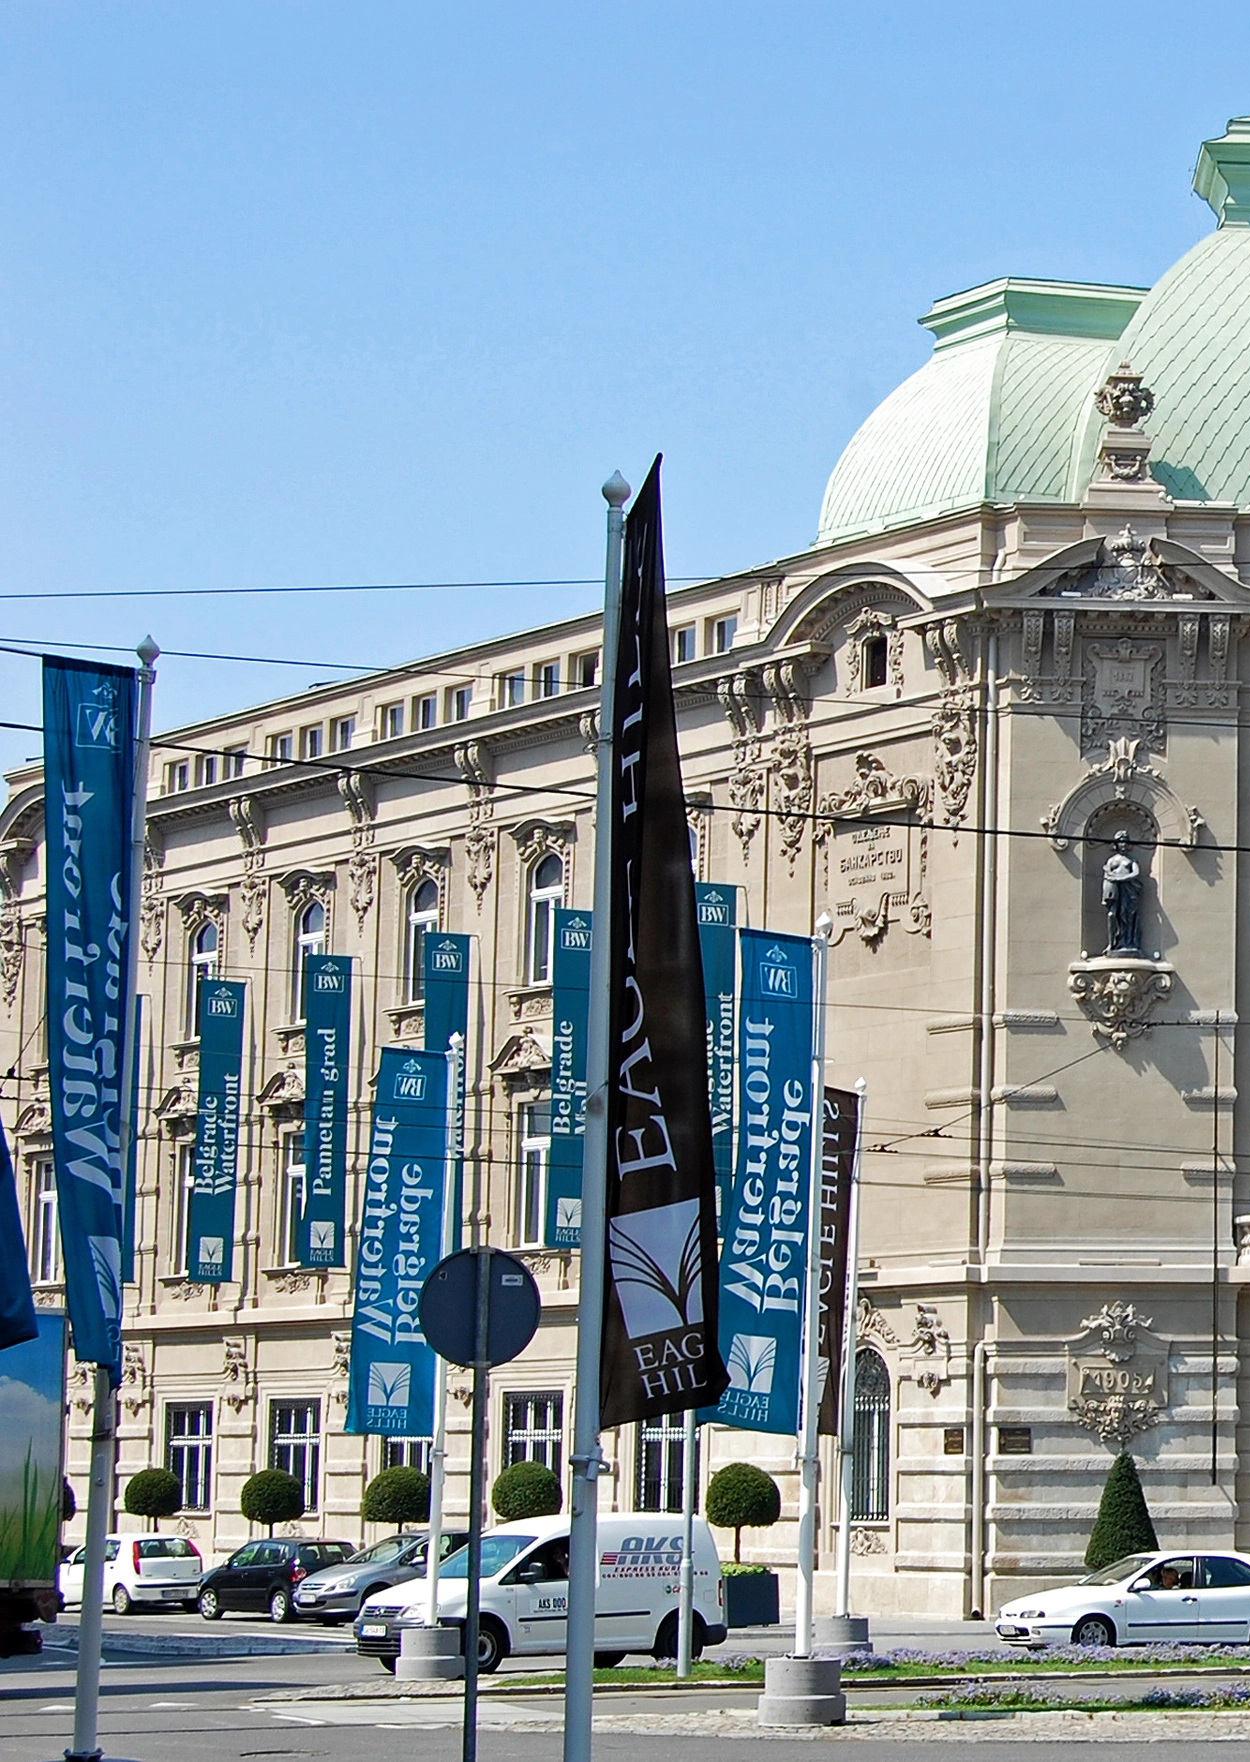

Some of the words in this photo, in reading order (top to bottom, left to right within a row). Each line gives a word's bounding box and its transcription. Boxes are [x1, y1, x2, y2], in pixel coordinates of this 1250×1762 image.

[701, 905, 726, 922] BW
[565, 930, 589, 947] BW
[436, 955, 459, 969] BW
[317, 975, 342, 989] BW
[211, 1000, 234, 1014] BW
[317, 1027, 339, 1082] grad
[712, 992, 734, 1137] Waterfront
[553, 1020, 576, 1134] Belgrade
[194, 1096, 218, 1196] Belgrade
[214, 1072, 239, 1196] Waterfront
[313, 1090, 333, 1195] Pametan
[633, 1333, 705, 1371] EAG
[641, 1364, 707, 1399] HIL
